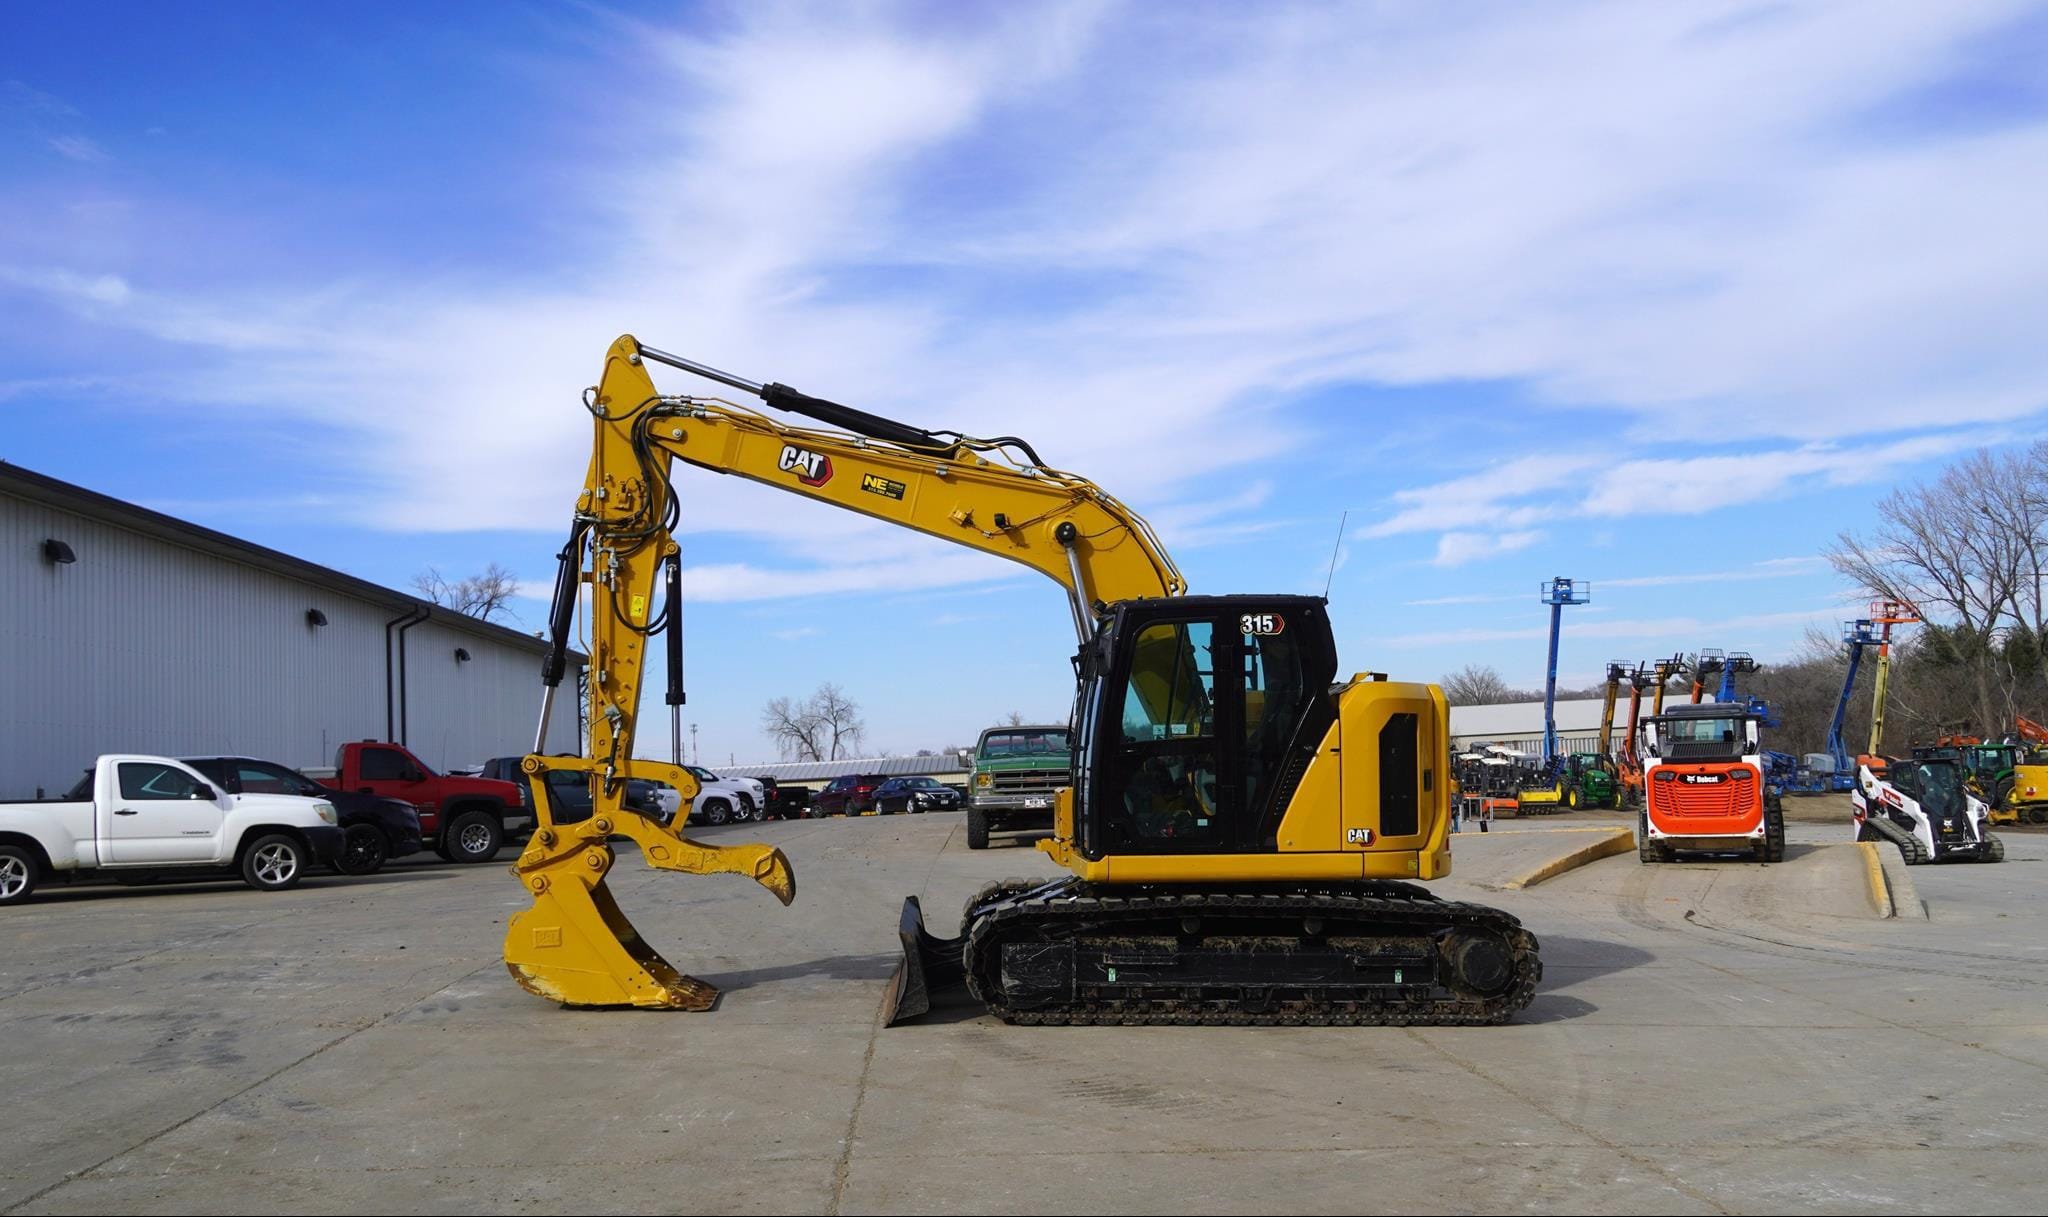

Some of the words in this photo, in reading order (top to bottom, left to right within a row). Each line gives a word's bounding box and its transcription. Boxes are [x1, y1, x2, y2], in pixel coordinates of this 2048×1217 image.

[780, 445, 824, 478] CAT
[864, 475, 888, 490] NE
[1242, 615, 1273, 632] 315
[1347, 829, 1370, 843] CAT
